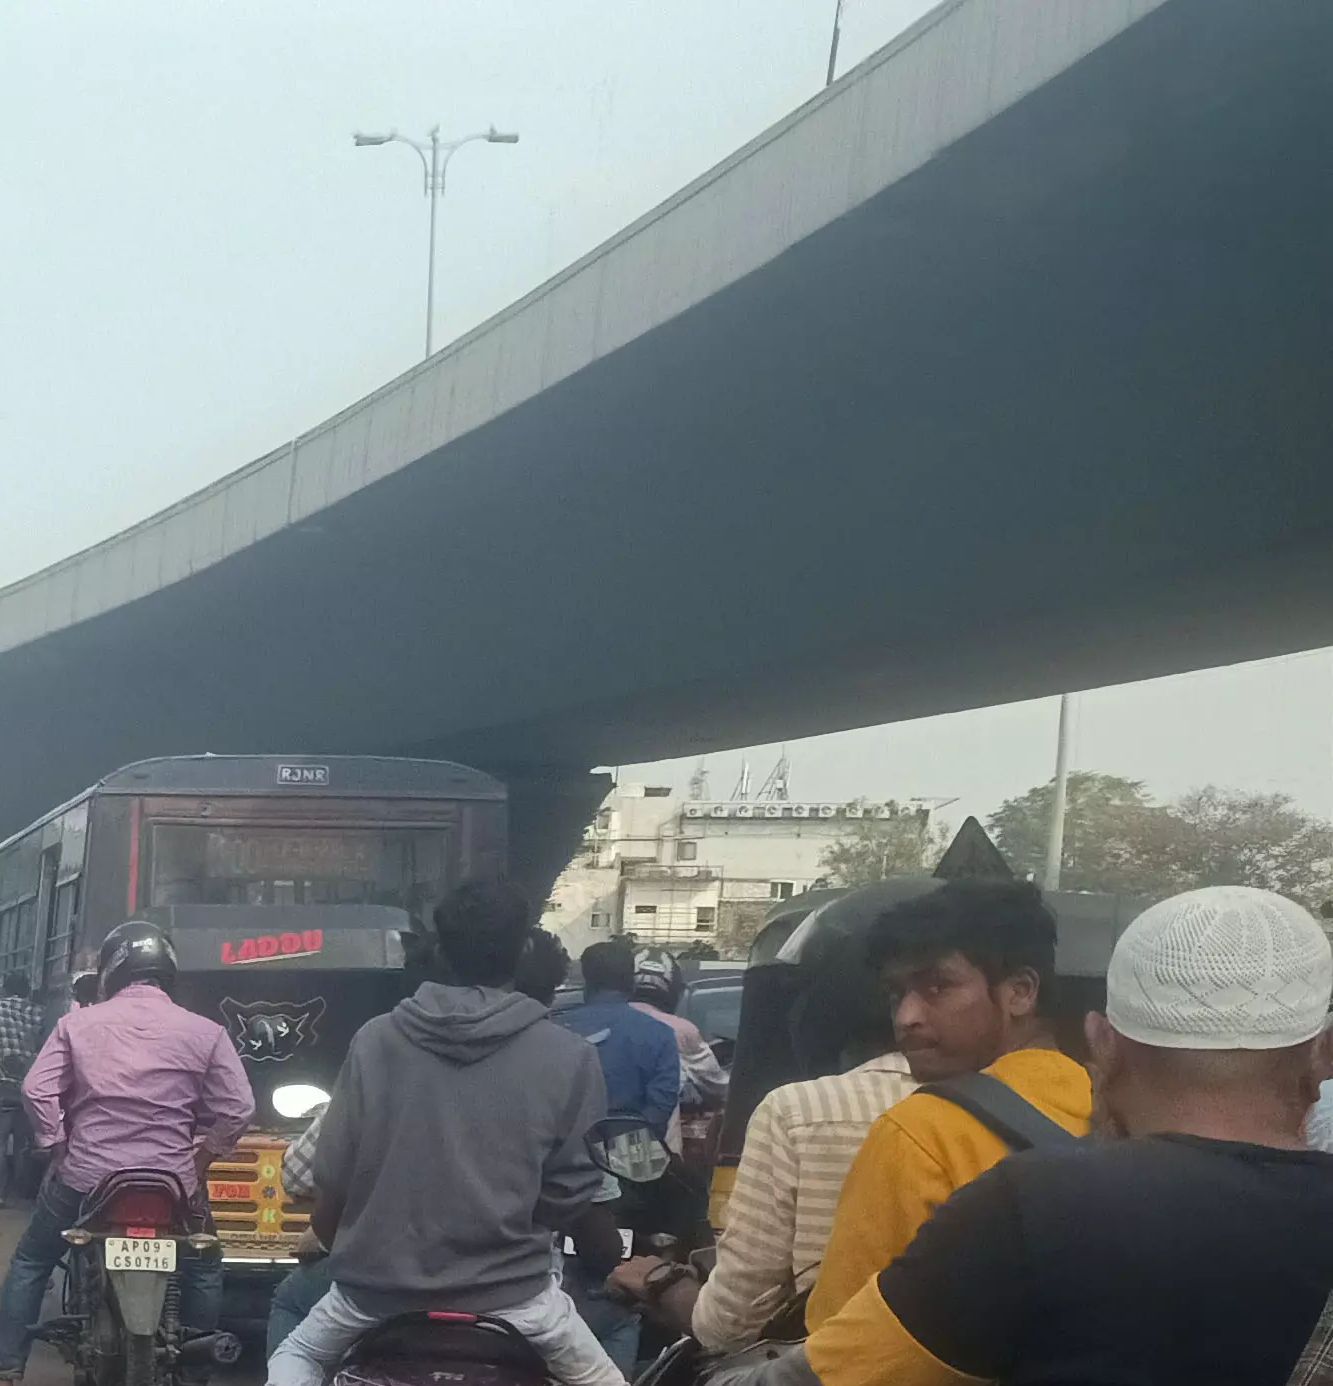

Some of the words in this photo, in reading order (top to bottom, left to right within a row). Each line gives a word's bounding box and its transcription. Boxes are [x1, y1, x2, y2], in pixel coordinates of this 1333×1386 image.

[281, 767, 326, 782] RJNR
[120, 1239, 161, 1253] AP09
[113, 1255, 170, 1269] CS0716
